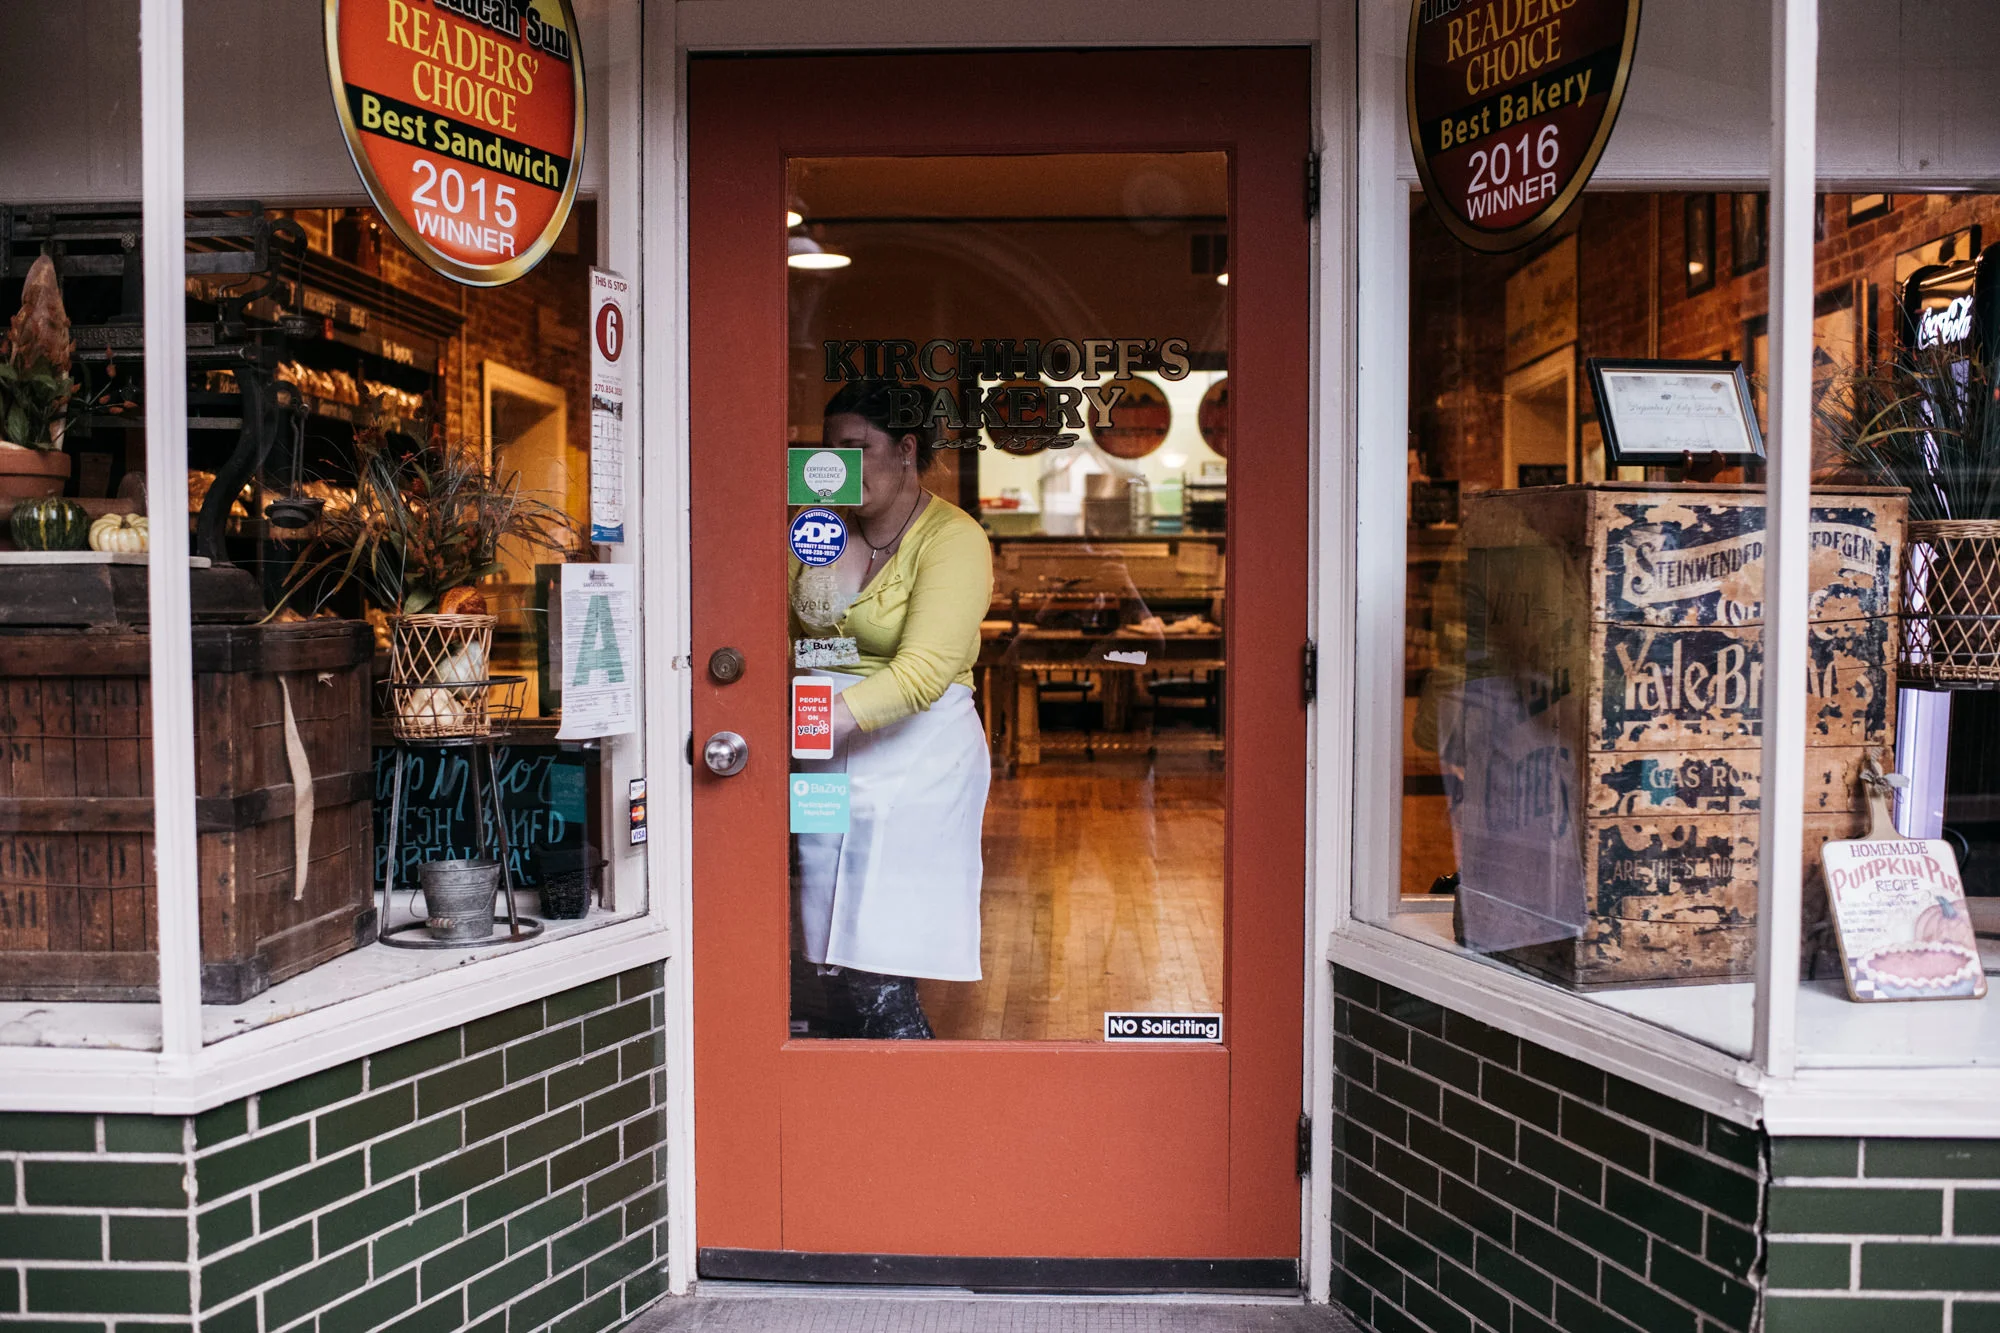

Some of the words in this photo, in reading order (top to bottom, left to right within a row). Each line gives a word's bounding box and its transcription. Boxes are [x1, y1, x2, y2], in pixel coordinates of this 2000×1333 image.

[387, 0, 539, 95] READERS'
[417, 0, 520, 38] ucah
[526, 6, 569, 58] Sun
[1446, 0, 1578, 63] READER
[1465, 19, 1562, 96] CHOICE
[412, 61, 518, 132] CHOICE
[1440, 105, 1491, 150] Best
[1499, 68, 1592, 128] Bakery
[361, 93, 427, 146] Best
[434, 118, 559, 187] Sandwich
[1467, 123, 1560, 194] 2016
[411, 158, 518, 229] 2015
[1466, 171, 1557, 222] WINNER
[414, 208, 516, 258] WINNER
[595, 275, 607, 287] THIS
[608, 279, 613, 289] IS
[613, 281, 628, 293] STOP
[605, 309, 617, 356] 6
[823, 337, 1191, 382] KIRCHHOFF'S
[886, 386, 1126, 430] BAKERY
[994, 433, 1080, 449] 1873
[792, 521, 843, 545] ADP
[805, 511, 829, 519] PROTECTED
[571, 594, 625, 687] A
[798, 724, 820, 736] yelp
[429, 748, 470, 821] in
[1650, 766, 1701, 789] GAS
[373, 806, 454, 847] RESH
[633, 829, 645, 841] VISA
[1850, 841, 1929, 858] HOMEMADE
[1613, 859, 1644, 881] ARE
[1830, 856, 1925, 903] PUMPKIN
[1875, 879, 1920, 893] RECIPE
[1110, 1019, 1138, 1035] NO
[1141, 1019, 1217, 1039] Soliciting
